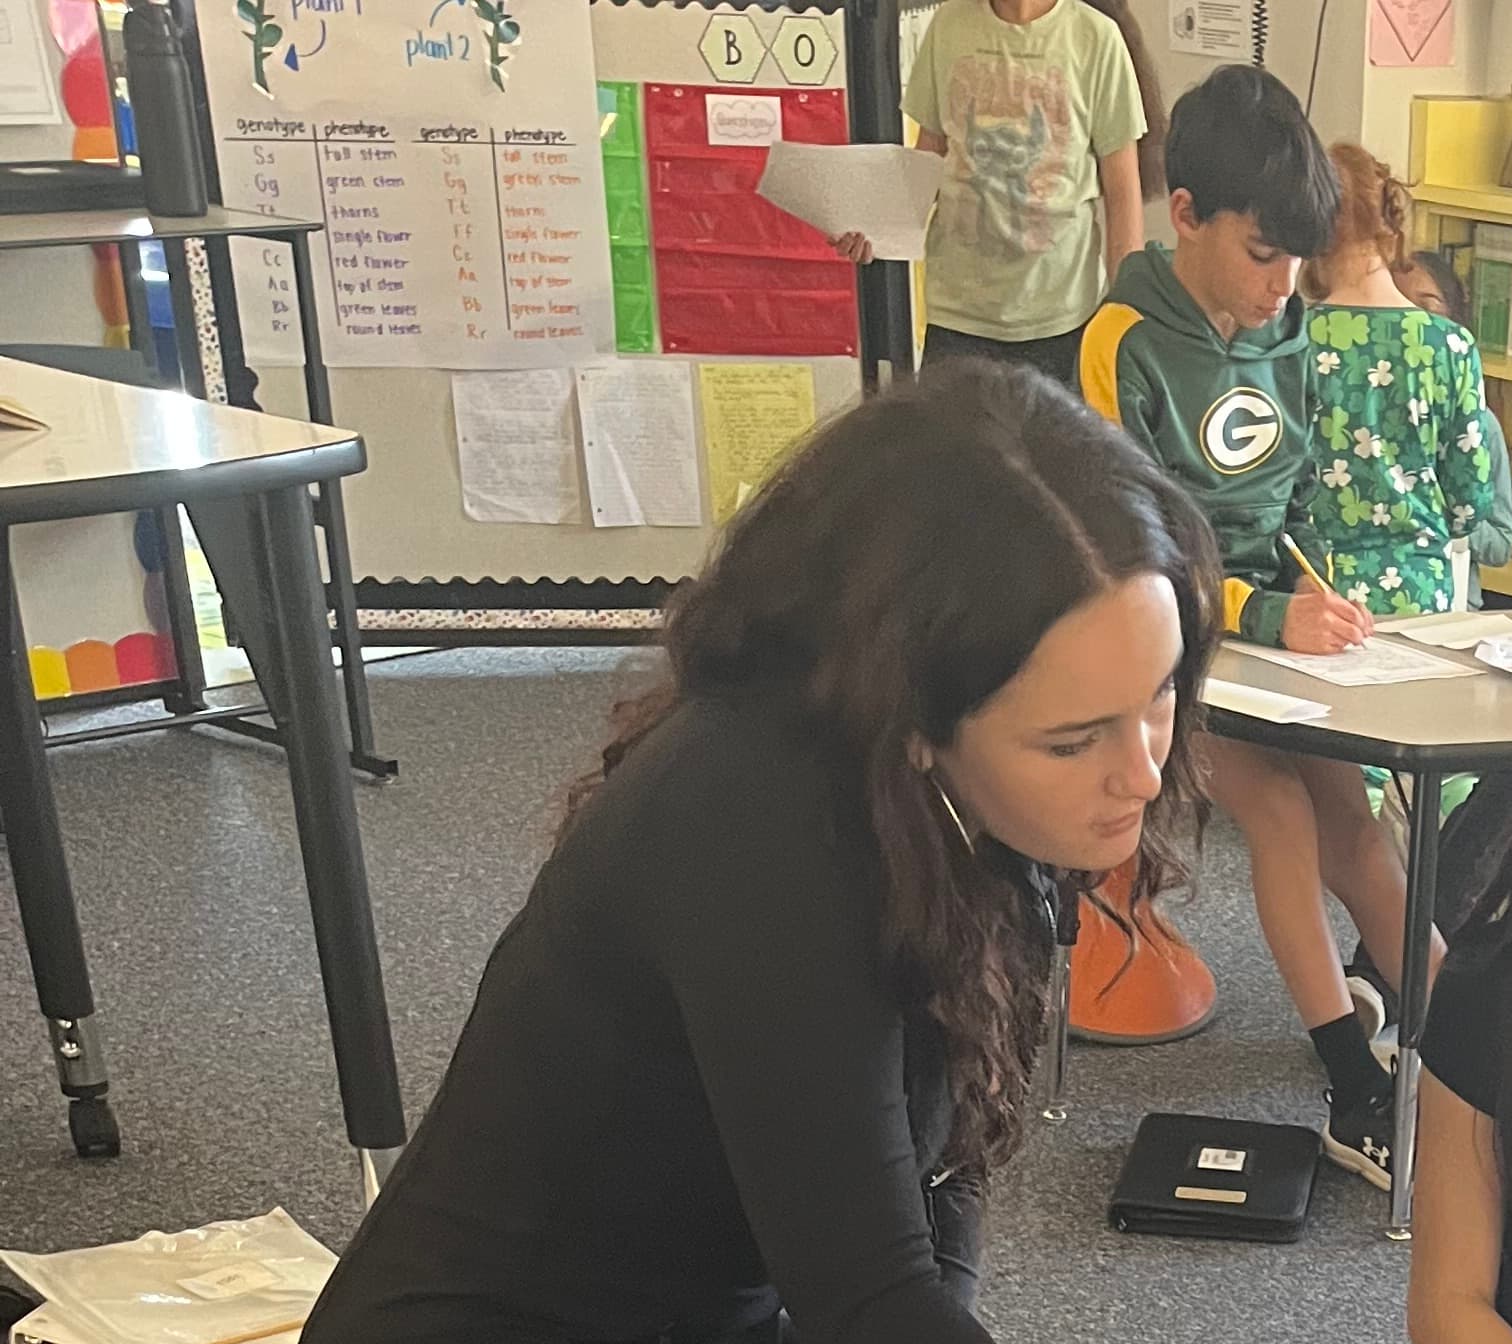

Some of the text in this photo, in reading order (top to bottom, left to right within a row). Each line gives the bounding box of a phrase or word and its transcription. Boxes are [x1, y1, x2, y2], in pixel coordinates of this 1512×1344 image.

[406, 31, 470, 67] plant 2
[724, 29, 742, 65] B
[794, 34, 815, 67] O
[237, 117, 305, 138] genotype
[420, 125, 567, 145] genotype phenotype
[325, 145, 351, 161] tall
[331, 204, 379, 219] thorns
[1203, 390, 1281, 471] G
